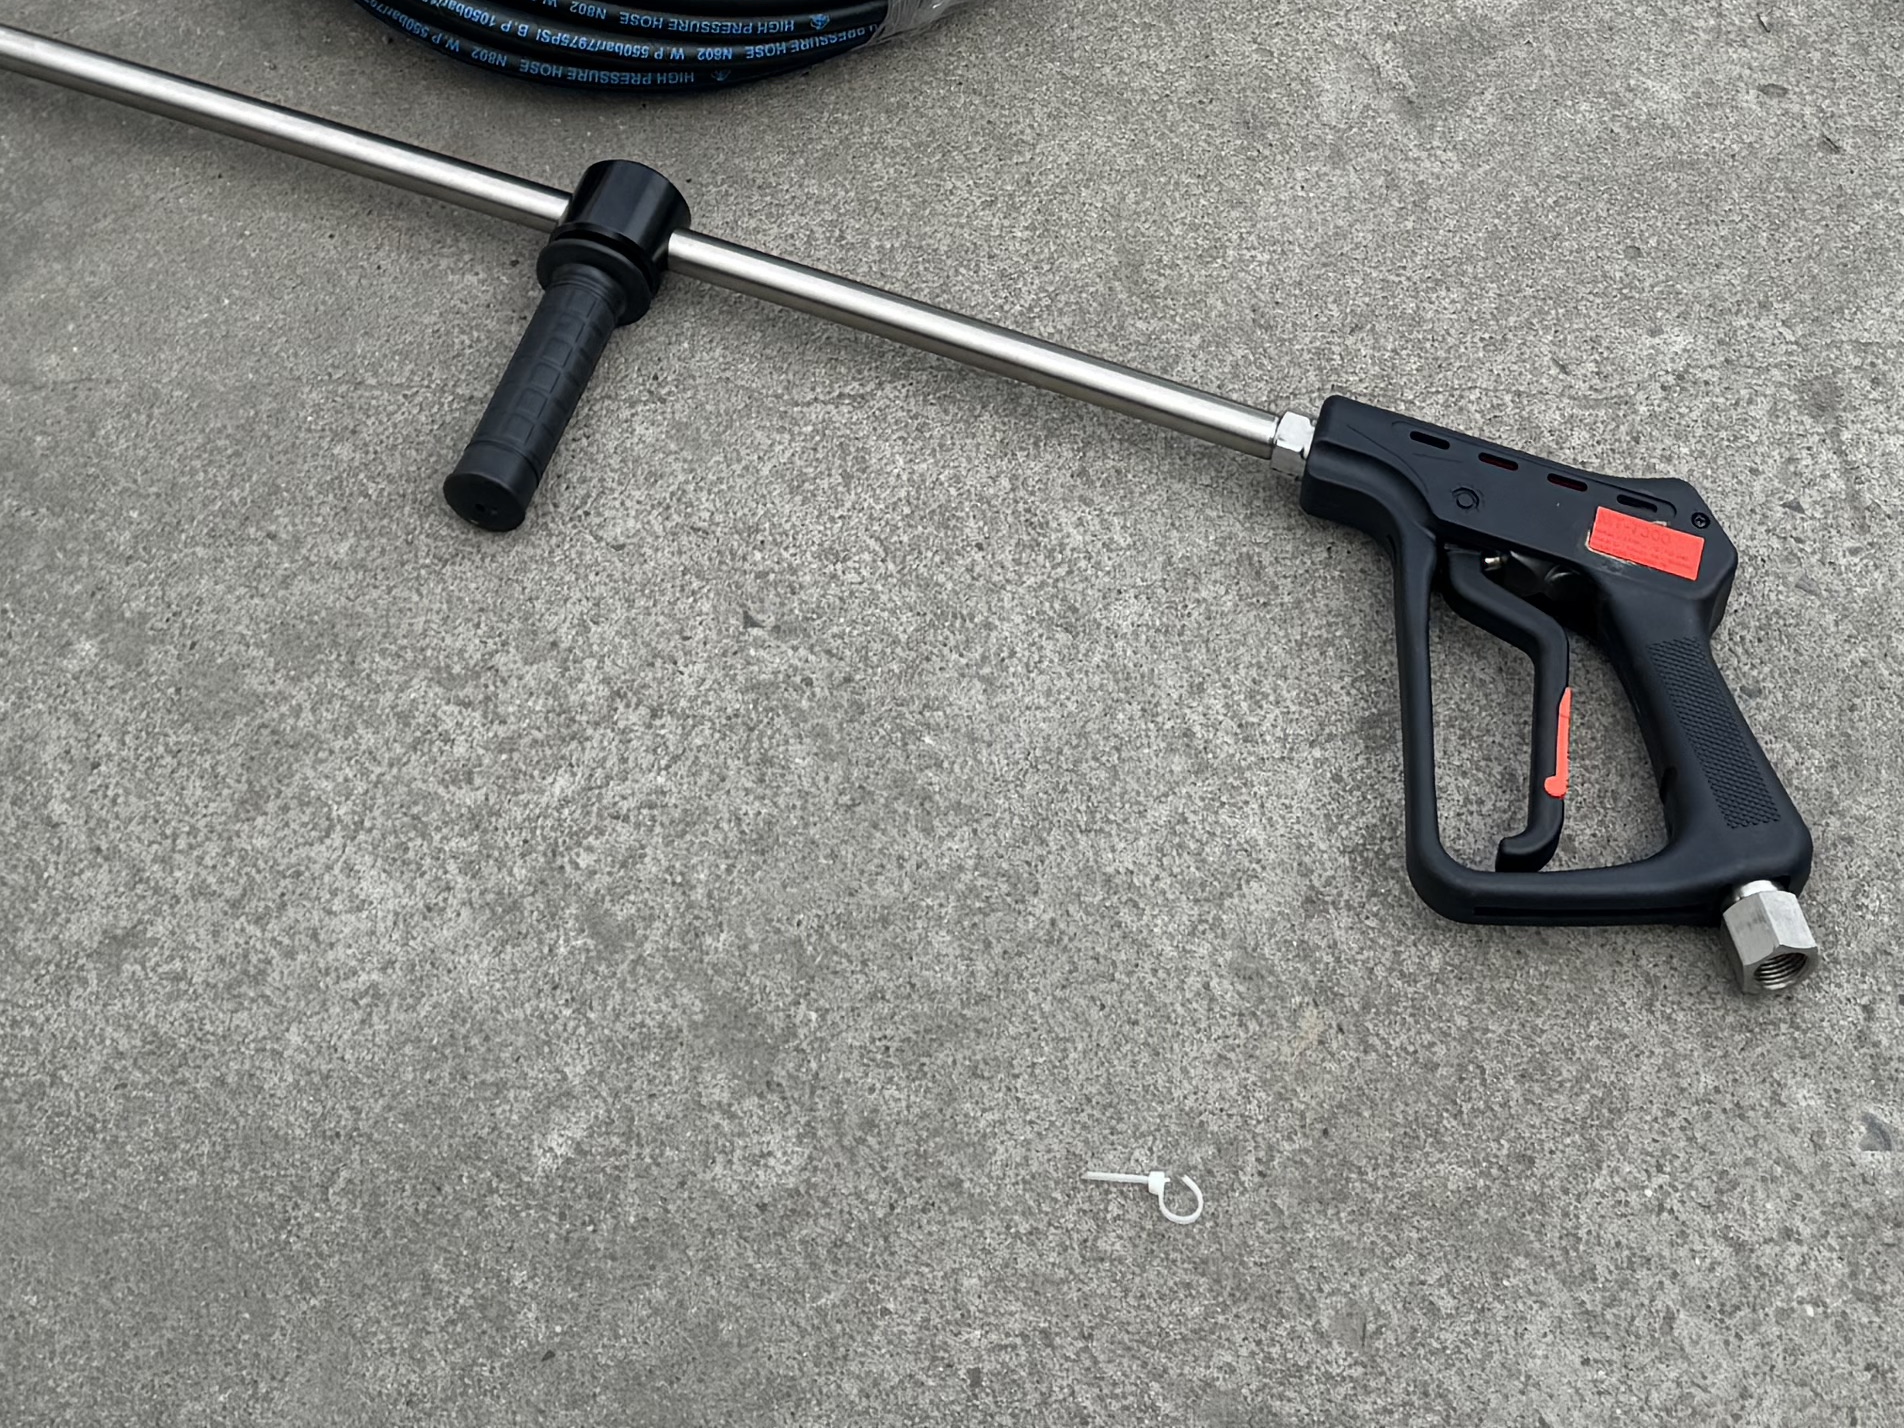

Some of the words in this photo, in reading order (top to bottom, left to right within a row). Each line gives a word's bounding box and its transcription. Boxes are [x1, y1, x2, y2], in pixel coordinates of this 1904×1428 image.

[569, 0, 607, 20] N802
[619, 11, 664, 30] HOSE
[668, 17, 753, 34] PRESSURE
[757, 18, 796, 33] HIGH
[500, 19, 530, 39] B.P
[470, 46, 508, 67] N802
[654, 46, 686, 61] W.P
[697, 47, 733, 61] N802
[745, 43, 787, 59] HOSE
[519, 58, 563, 79] HOSE
[566, 69, 652, 85] PRESSURE
[656, 70, 695, 84] HIGH
